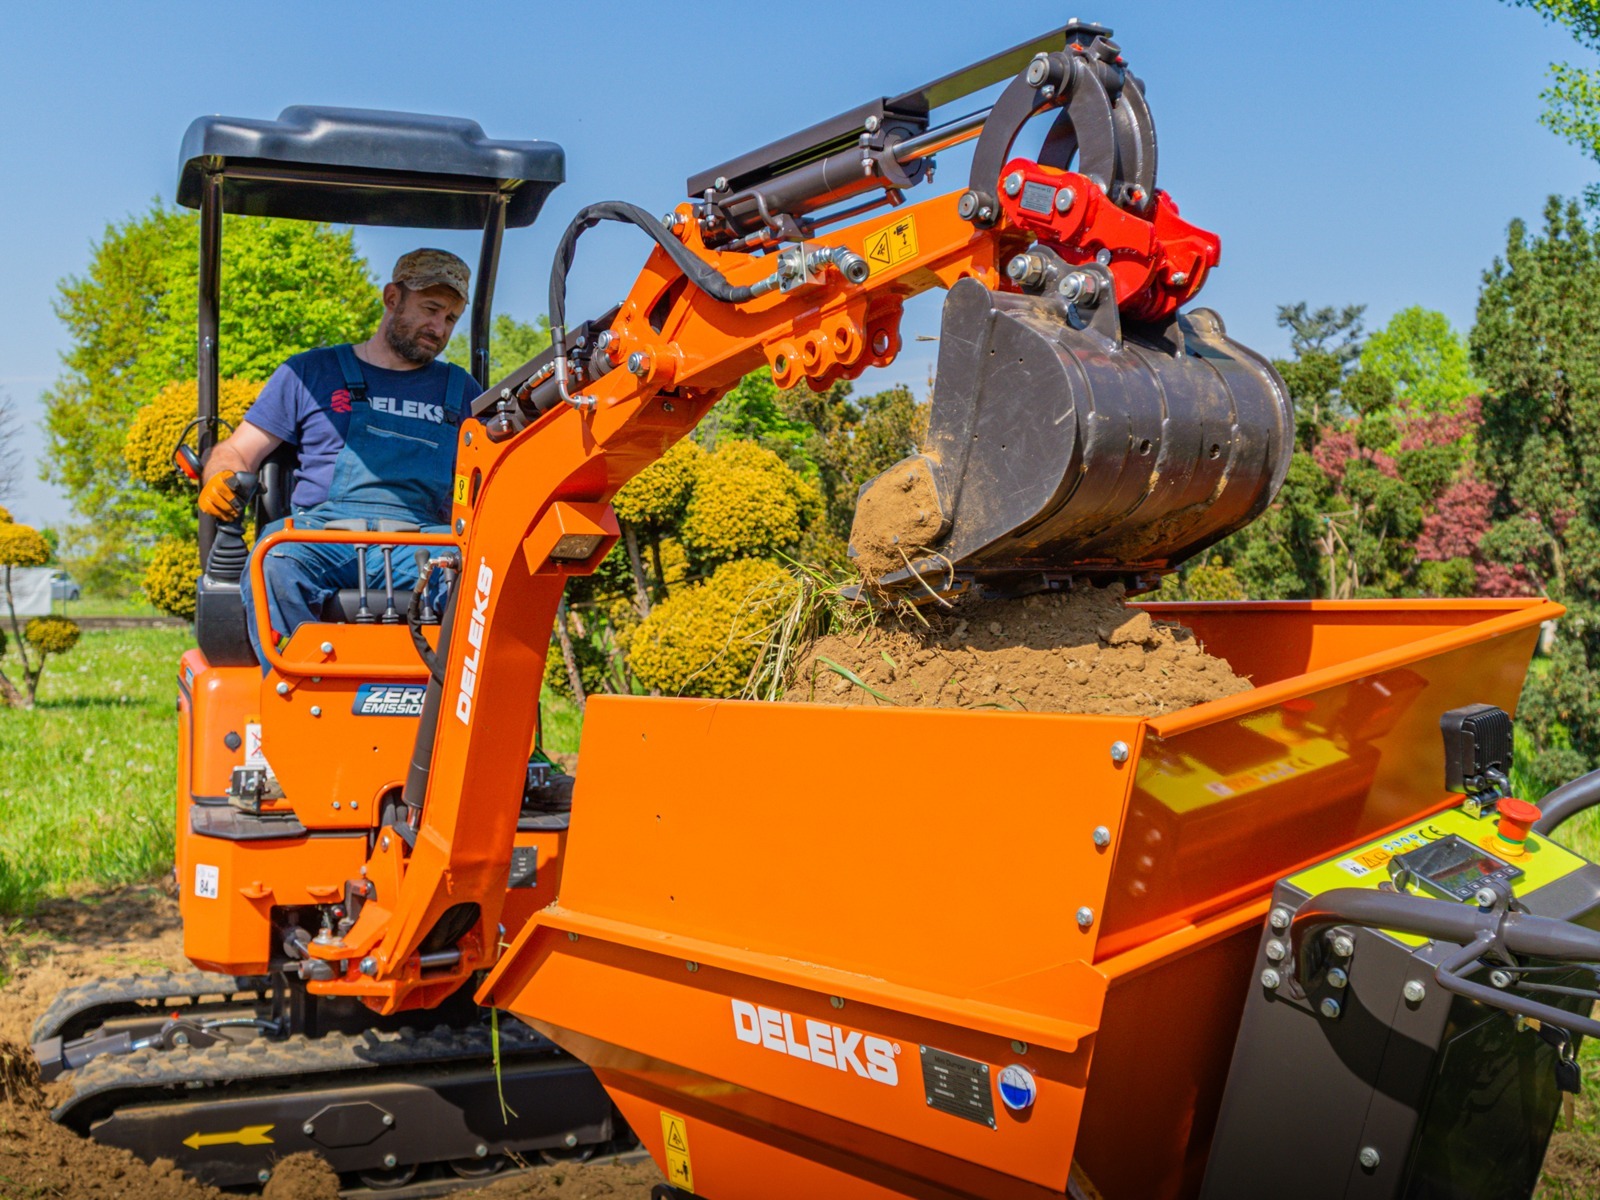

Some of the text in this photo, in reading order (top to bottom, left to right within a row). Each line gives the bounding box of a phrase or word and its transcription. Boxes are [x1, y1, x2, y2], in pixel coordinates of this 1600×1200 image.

[367, 396, 444, 424] ELEKS
[456, 563, 494, 726] DELEKS
[361, 703, 424, 714] EMISSIO
